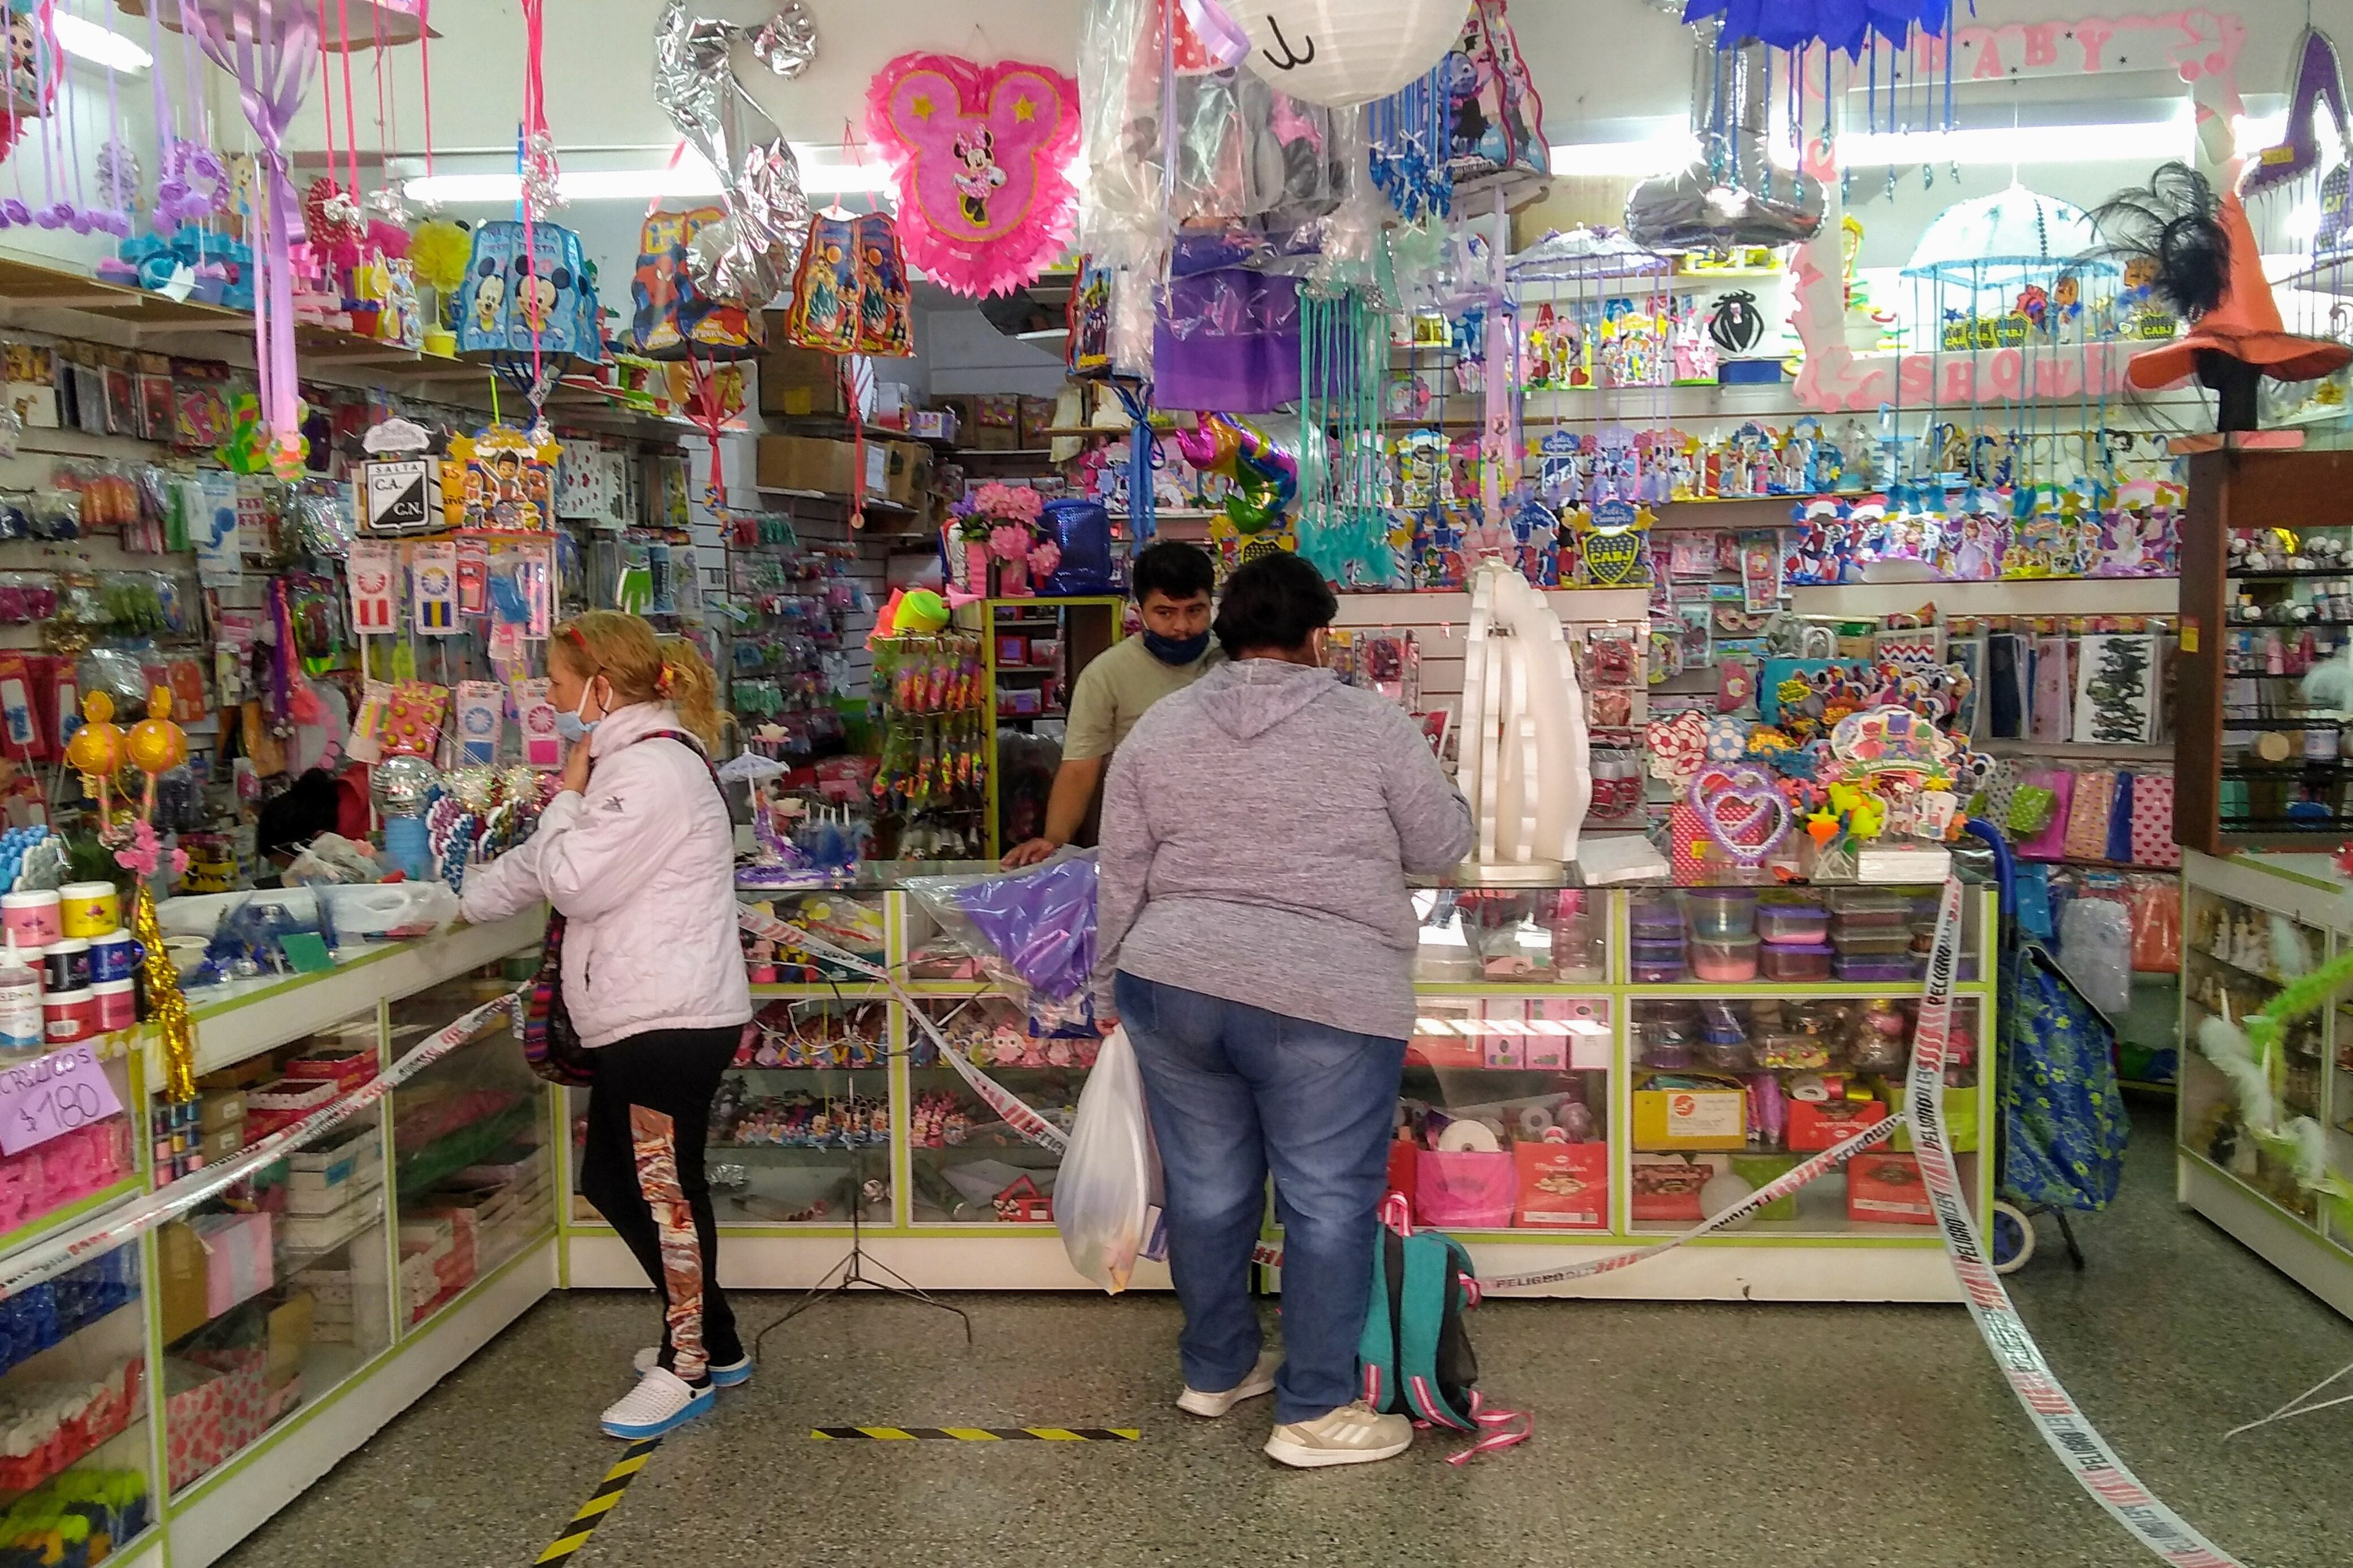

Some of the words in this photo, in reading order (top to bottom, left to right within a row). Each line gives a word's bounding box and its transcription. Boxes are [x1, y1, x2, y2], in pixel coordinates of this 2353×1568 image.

[1919, 26, 2113, 79] BABY
[2144, 326, 2173, 335] CABJ
[1899, 342, 2118, 403] SHOWE
[376, 464, 419, 474] SALTA
[393, 501, 423, 516] C.N.
[1590, 550, 1632, 564] CABJ
[1496, 1272, 1565, 1289] PELIGRO
